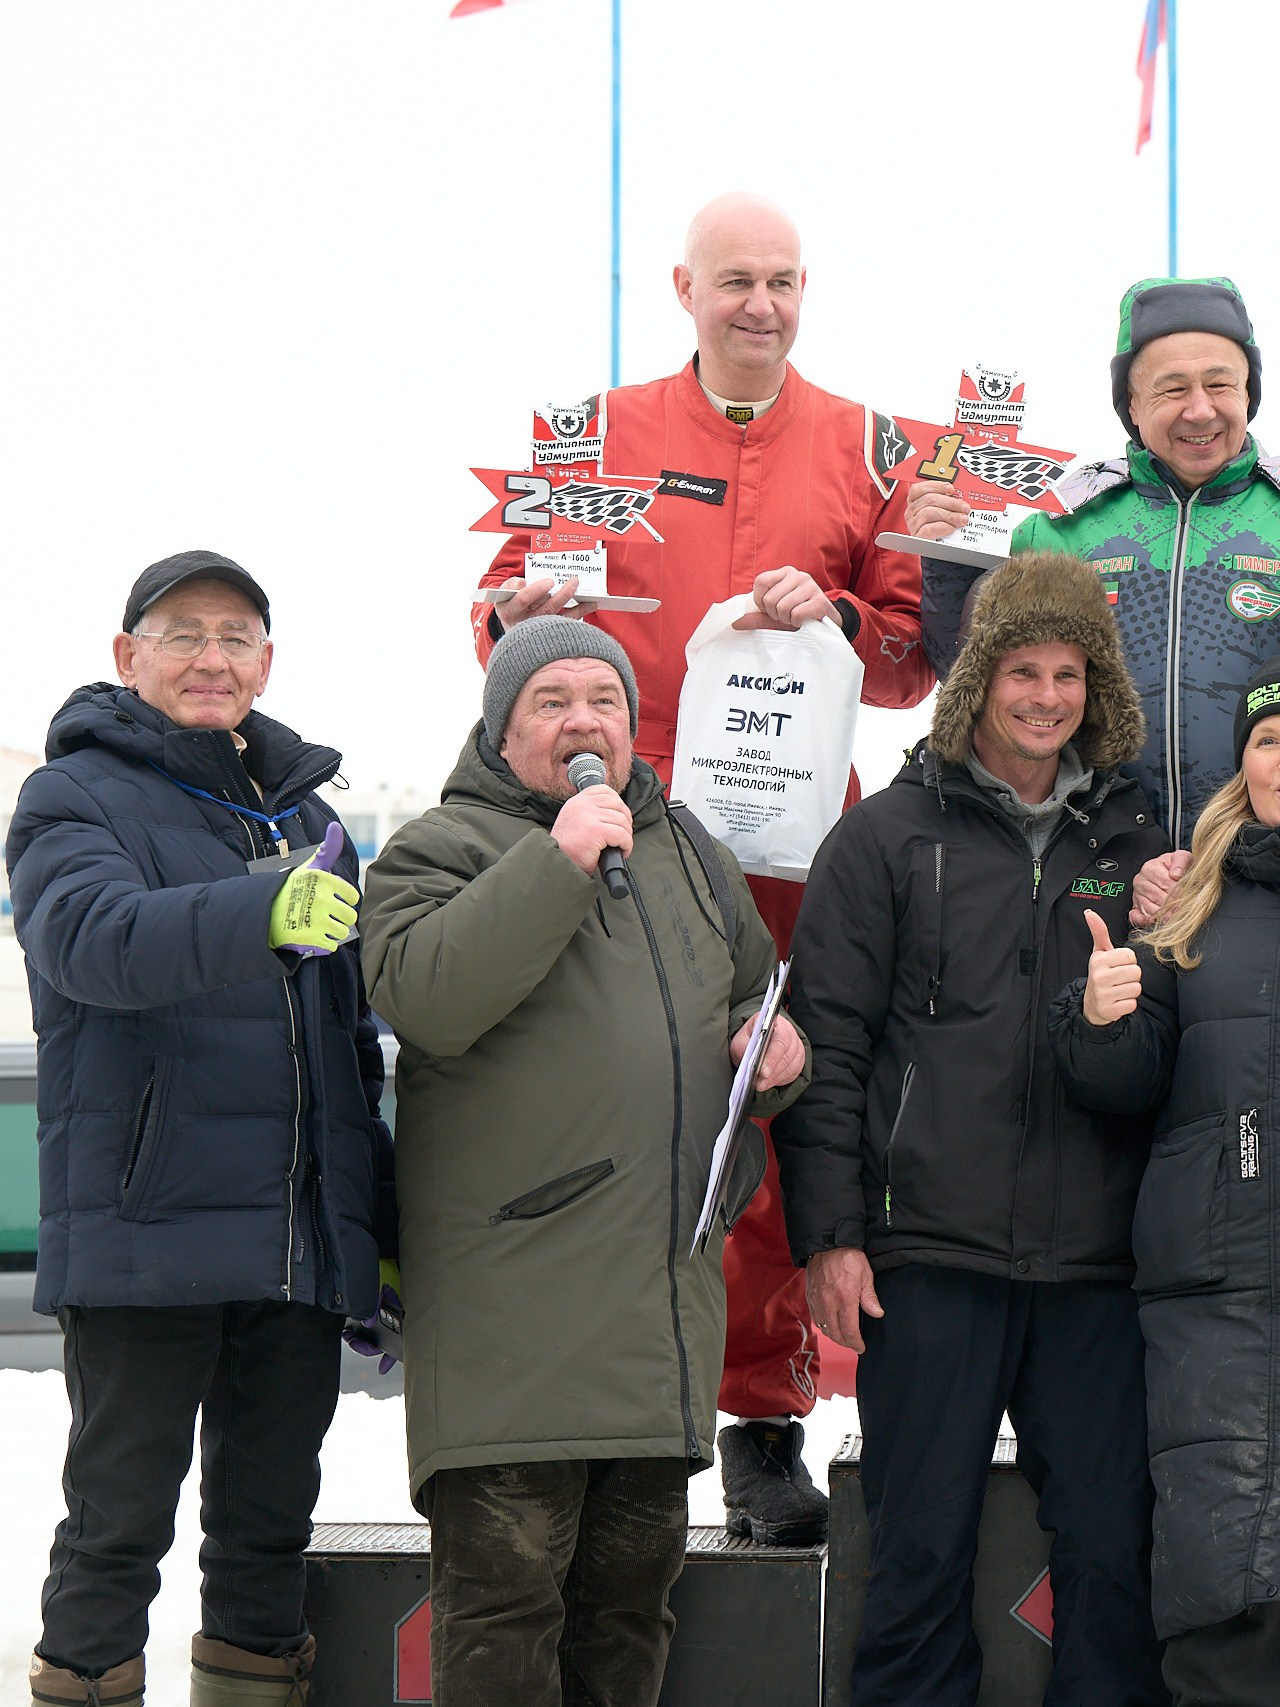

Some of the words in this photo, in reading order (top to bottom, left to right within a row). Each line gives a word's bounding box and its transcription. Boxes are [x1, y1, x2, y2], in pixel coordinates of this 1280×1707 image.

[728, 412, 752, 420] OMP
[916, 433, 965, 483] 1
[502, 475, 552, 529] 2
[531, 561, 566, 570] Ижевский
[567, 565, 602, 573] ипподром
[1088, 556, 1132, 574] РСТАН
[727, 673, 805, 695] АКСИОН
[725, 708, 792, 737] ЗМТ
[736, 747, 771, 761] ЗАВОД
[691, 757, 813, 781] МИКРОЭЛЕКТРОННЫХ
[712, 774, 786, 793] ТЕХНОЛОГИЙ
